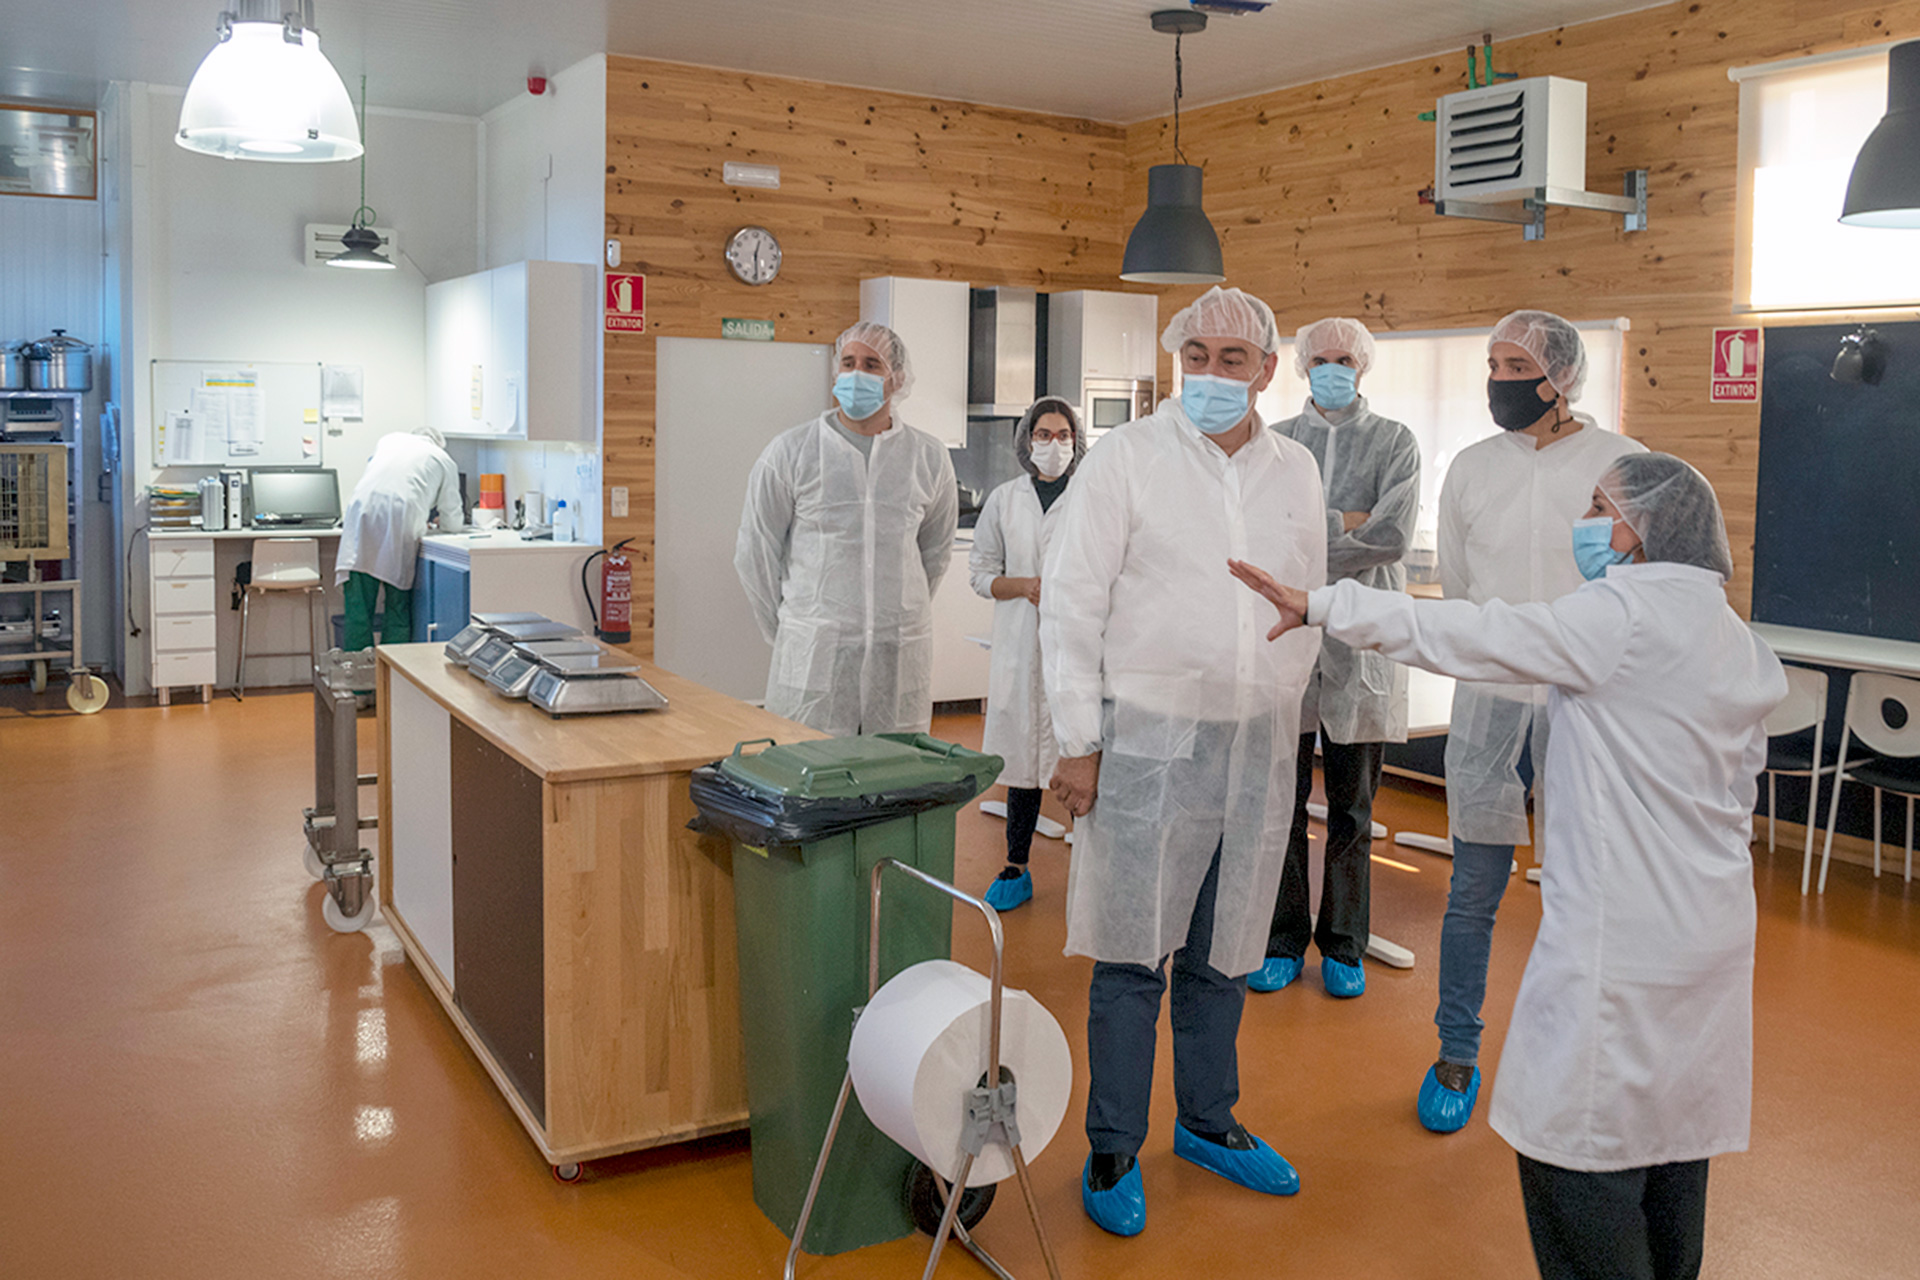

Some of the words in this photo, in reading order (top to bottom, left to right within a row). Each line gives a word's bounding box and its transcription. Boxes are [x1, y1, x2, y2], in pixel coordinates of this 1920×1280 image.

[607, 317, 642, 329] EXTINTOR
[726, 321, 770, 337] SALIDA
[1714, 384, 1755, 397] EXTINTOR
